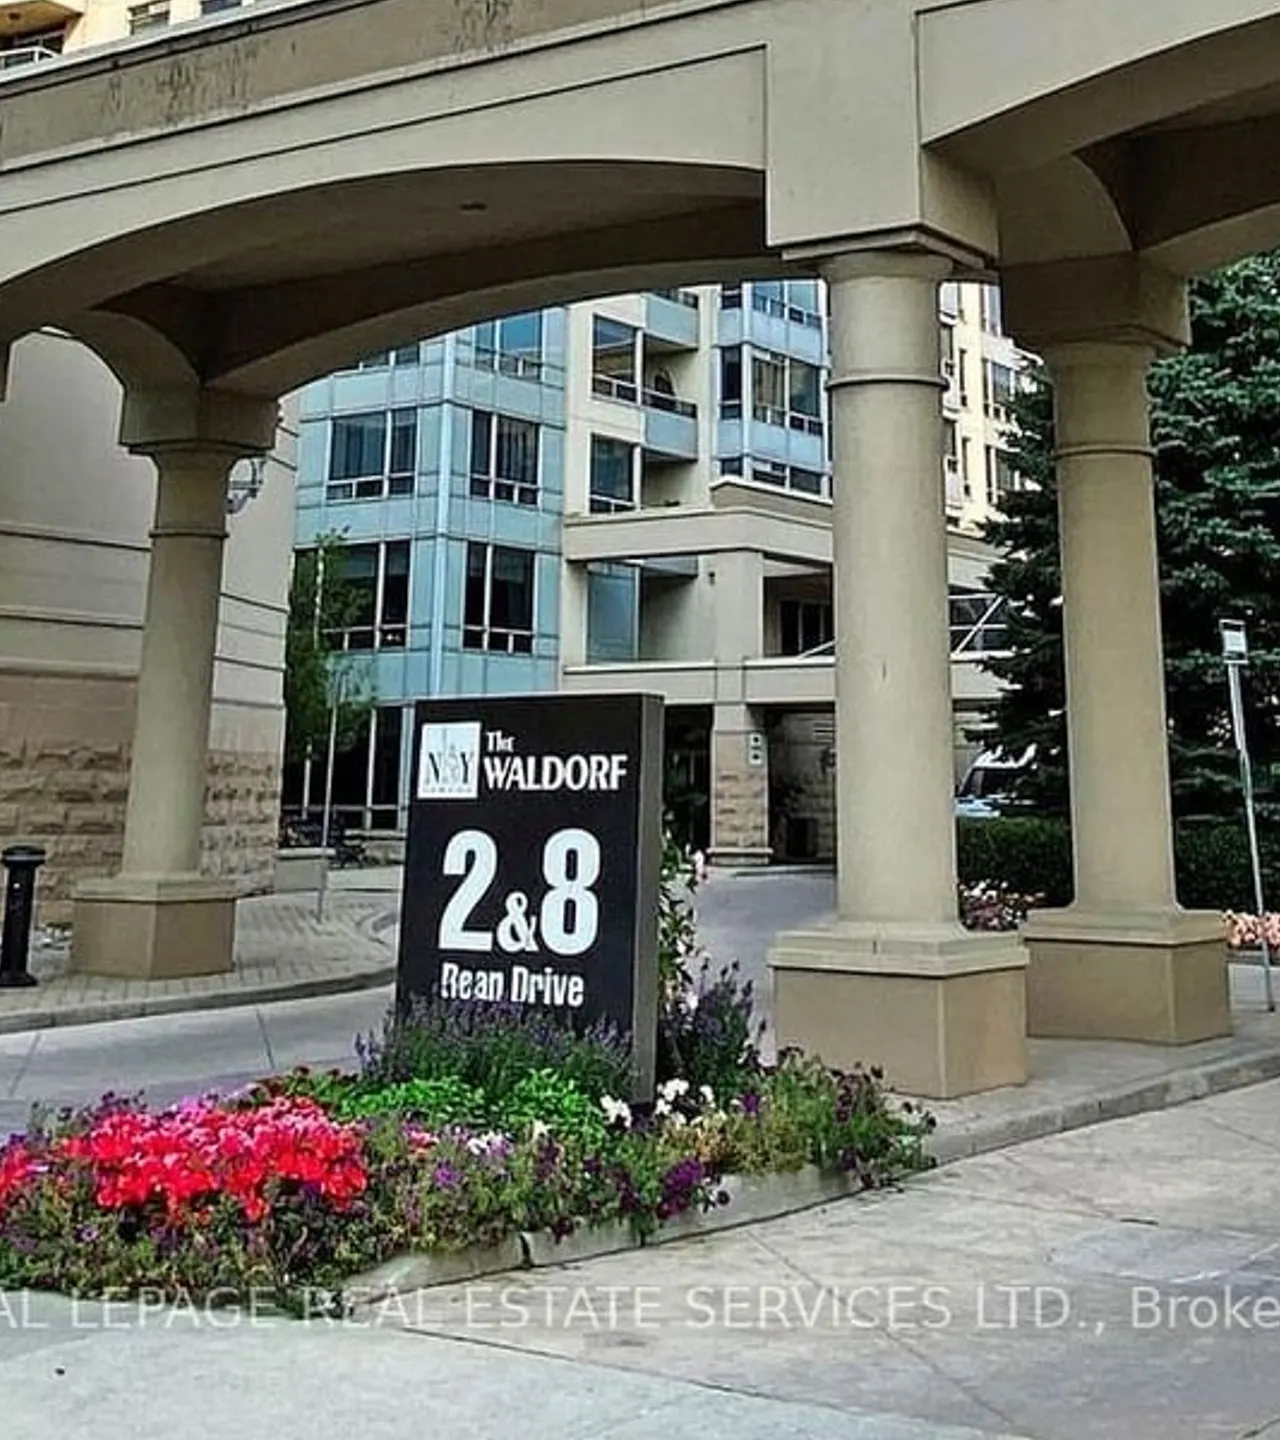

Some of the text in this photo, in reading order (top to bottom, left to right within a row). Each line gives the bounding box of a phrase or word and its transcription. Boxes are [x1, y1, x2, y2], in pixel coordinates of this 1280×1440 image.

[486, 731, 516, 752] The
[483, 755, 628, 791] WALDORF
[441, 962, 584, 1007] Rean Drive
